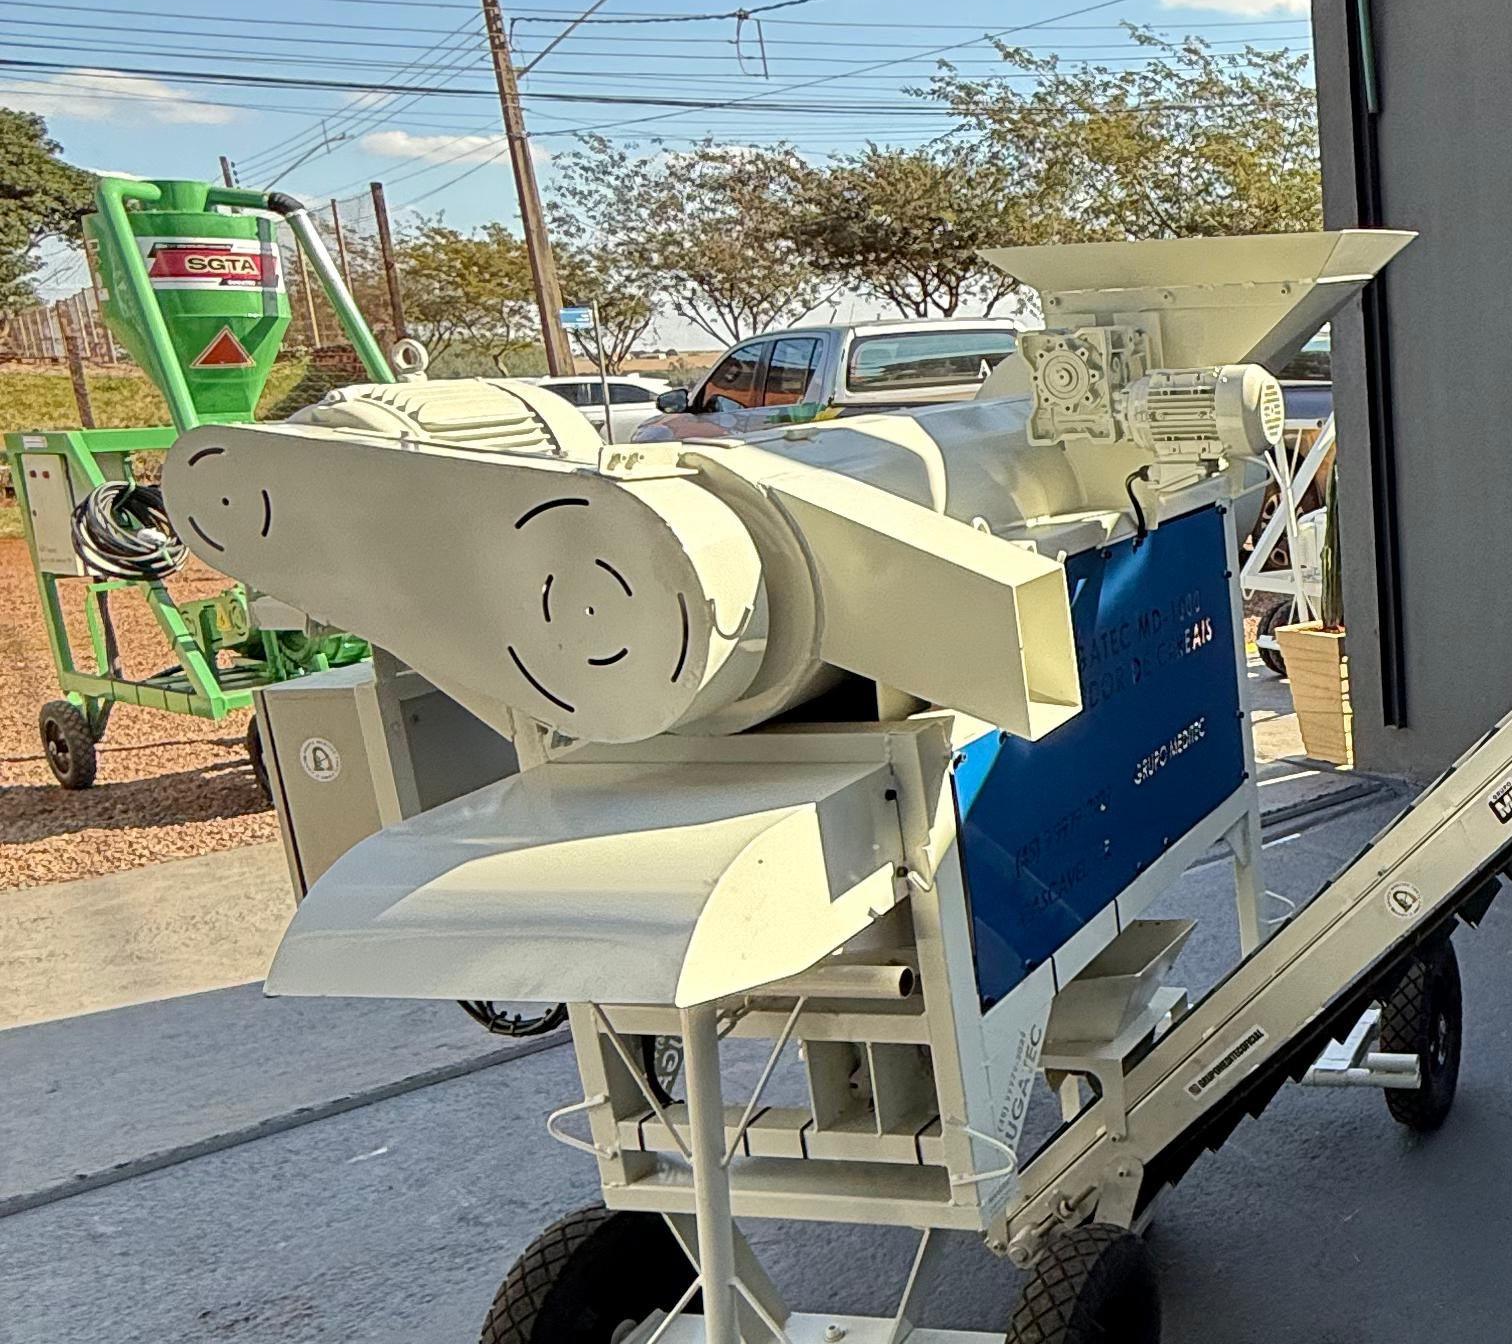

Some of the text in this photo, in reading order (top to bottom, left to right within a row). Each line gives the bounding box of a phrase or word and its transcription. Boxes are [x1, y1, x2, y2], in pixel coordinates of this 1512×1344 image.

[186, 256, 256, 273] SGTA
[1134, 716, 1206, 785] GRUPO MEDITEC
[1492, 780, 1512, 800] GRUPO
[1004, 1023, 1042, 1150] UGATEC
